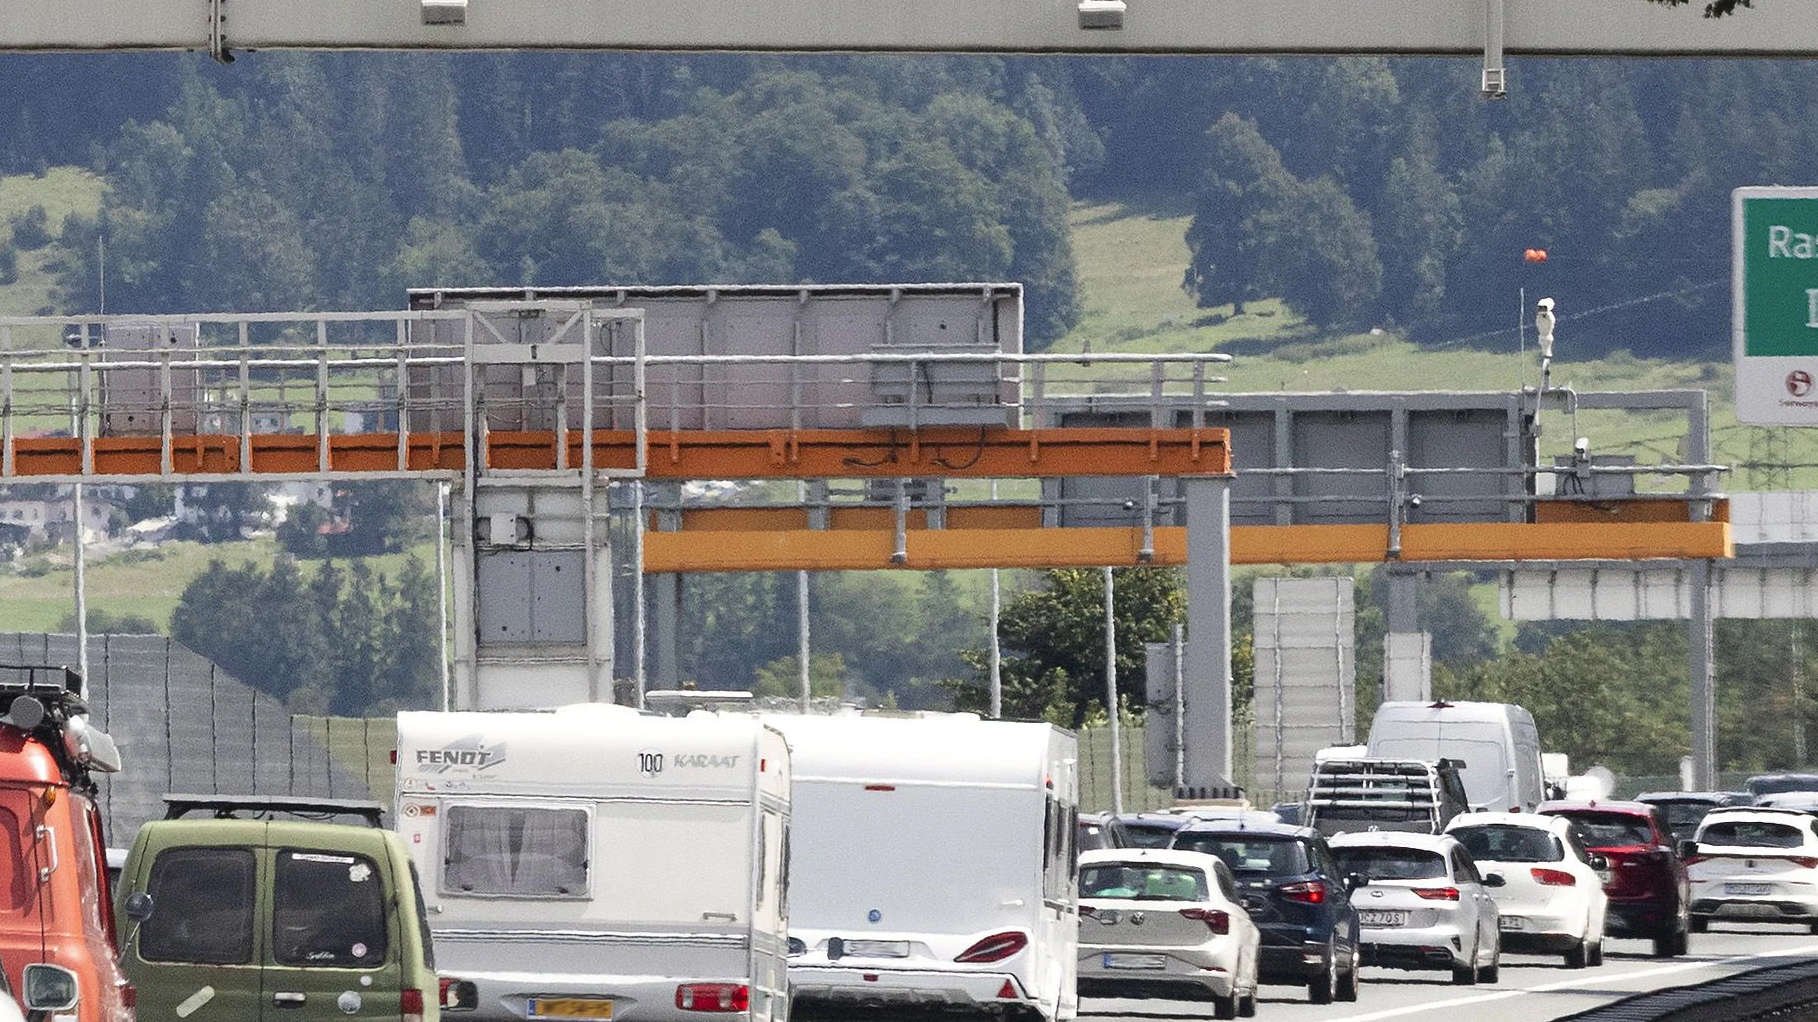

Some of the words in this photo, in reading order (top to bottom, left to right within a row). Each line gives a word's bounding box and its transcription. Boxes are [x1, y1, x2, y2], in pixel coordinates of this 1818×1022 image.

[1769, 225, 1818, 259] Ra
[416, 750, 491, 765] FENDT
[638, 753, 663, 773] 100
